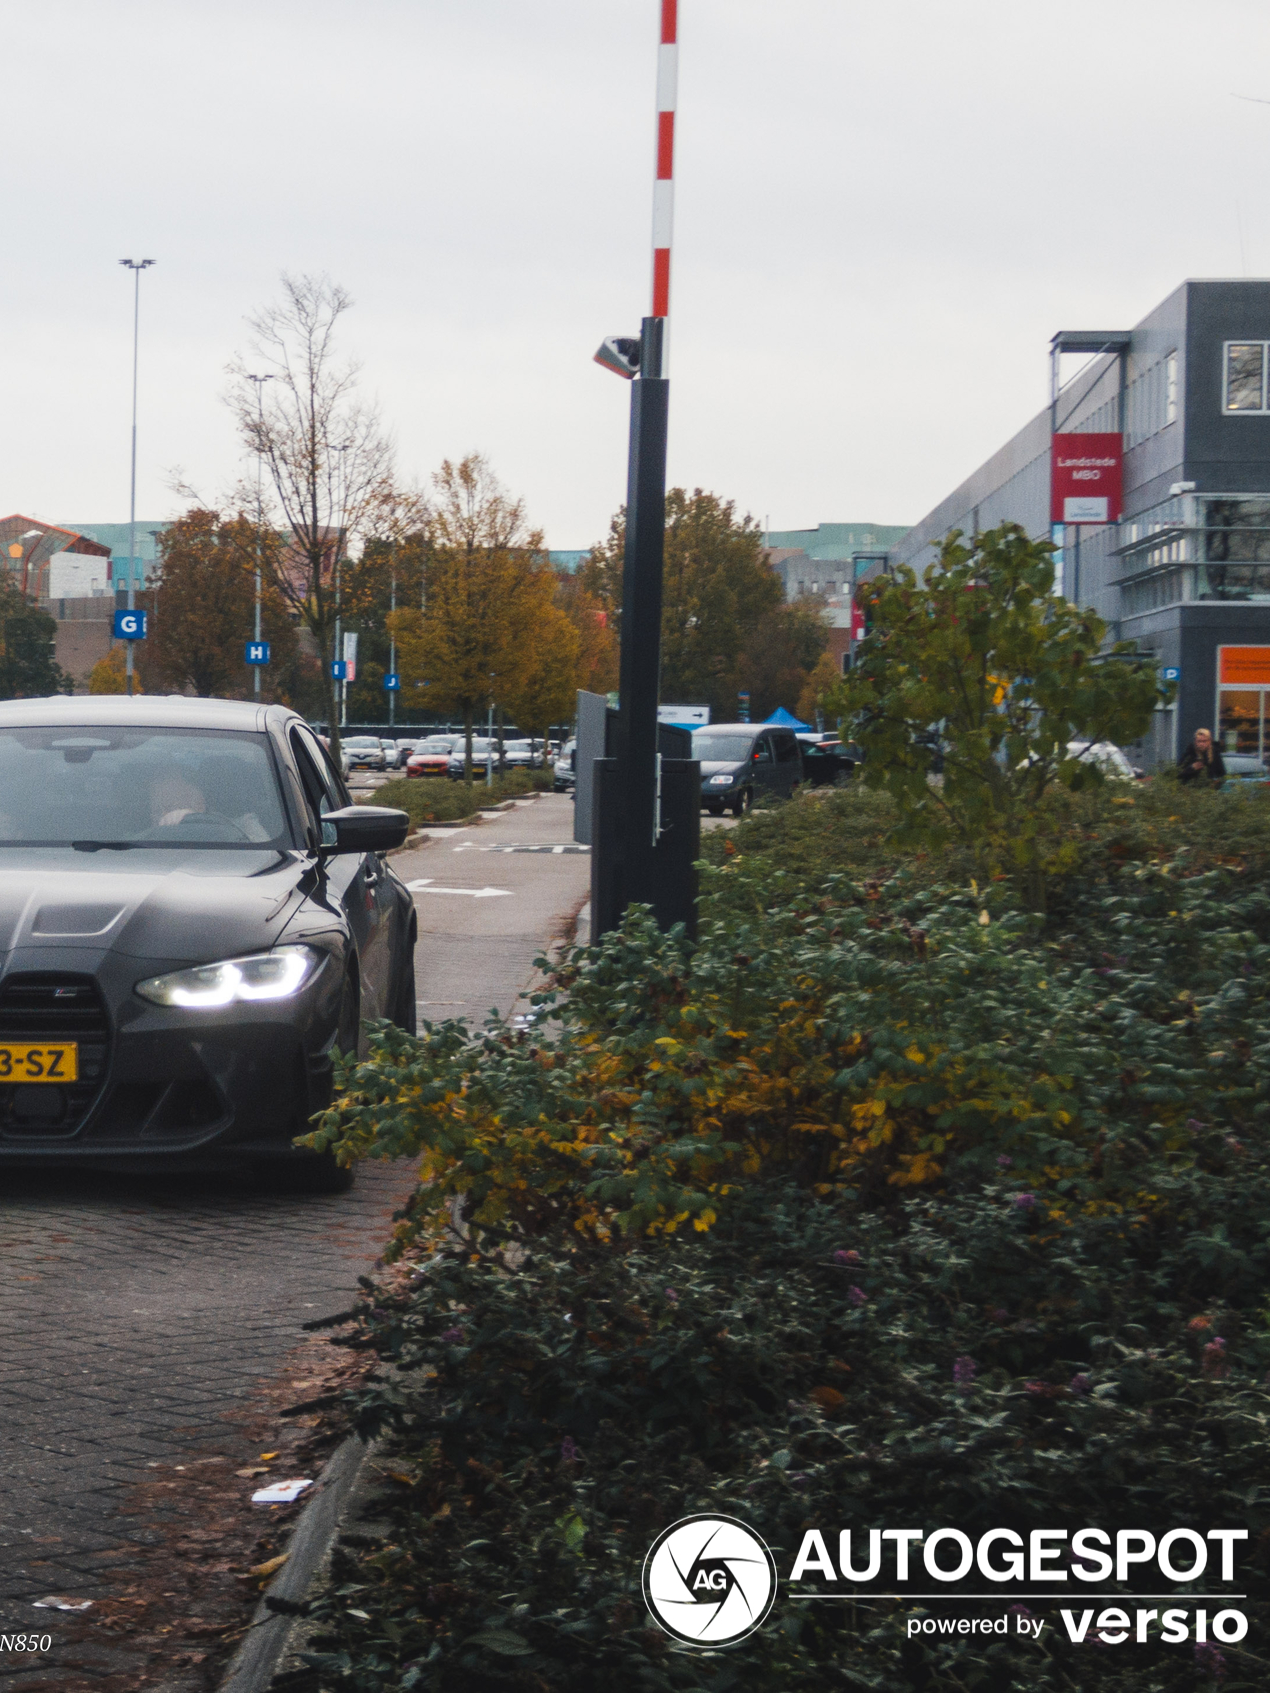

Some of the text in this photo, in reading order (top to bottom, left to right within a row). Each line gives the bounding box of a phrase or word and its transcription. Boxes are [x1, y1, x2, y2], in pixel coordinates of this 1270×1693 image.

[1057, 457, 1116, 467] Landstede
[1072, 470, 1101, 480] MBO
[121, 615, 138, 633] G
[250, 646, 263, 659] H
[1166, 668, 1178, 679] P
[387, 677, 396, 687] J
